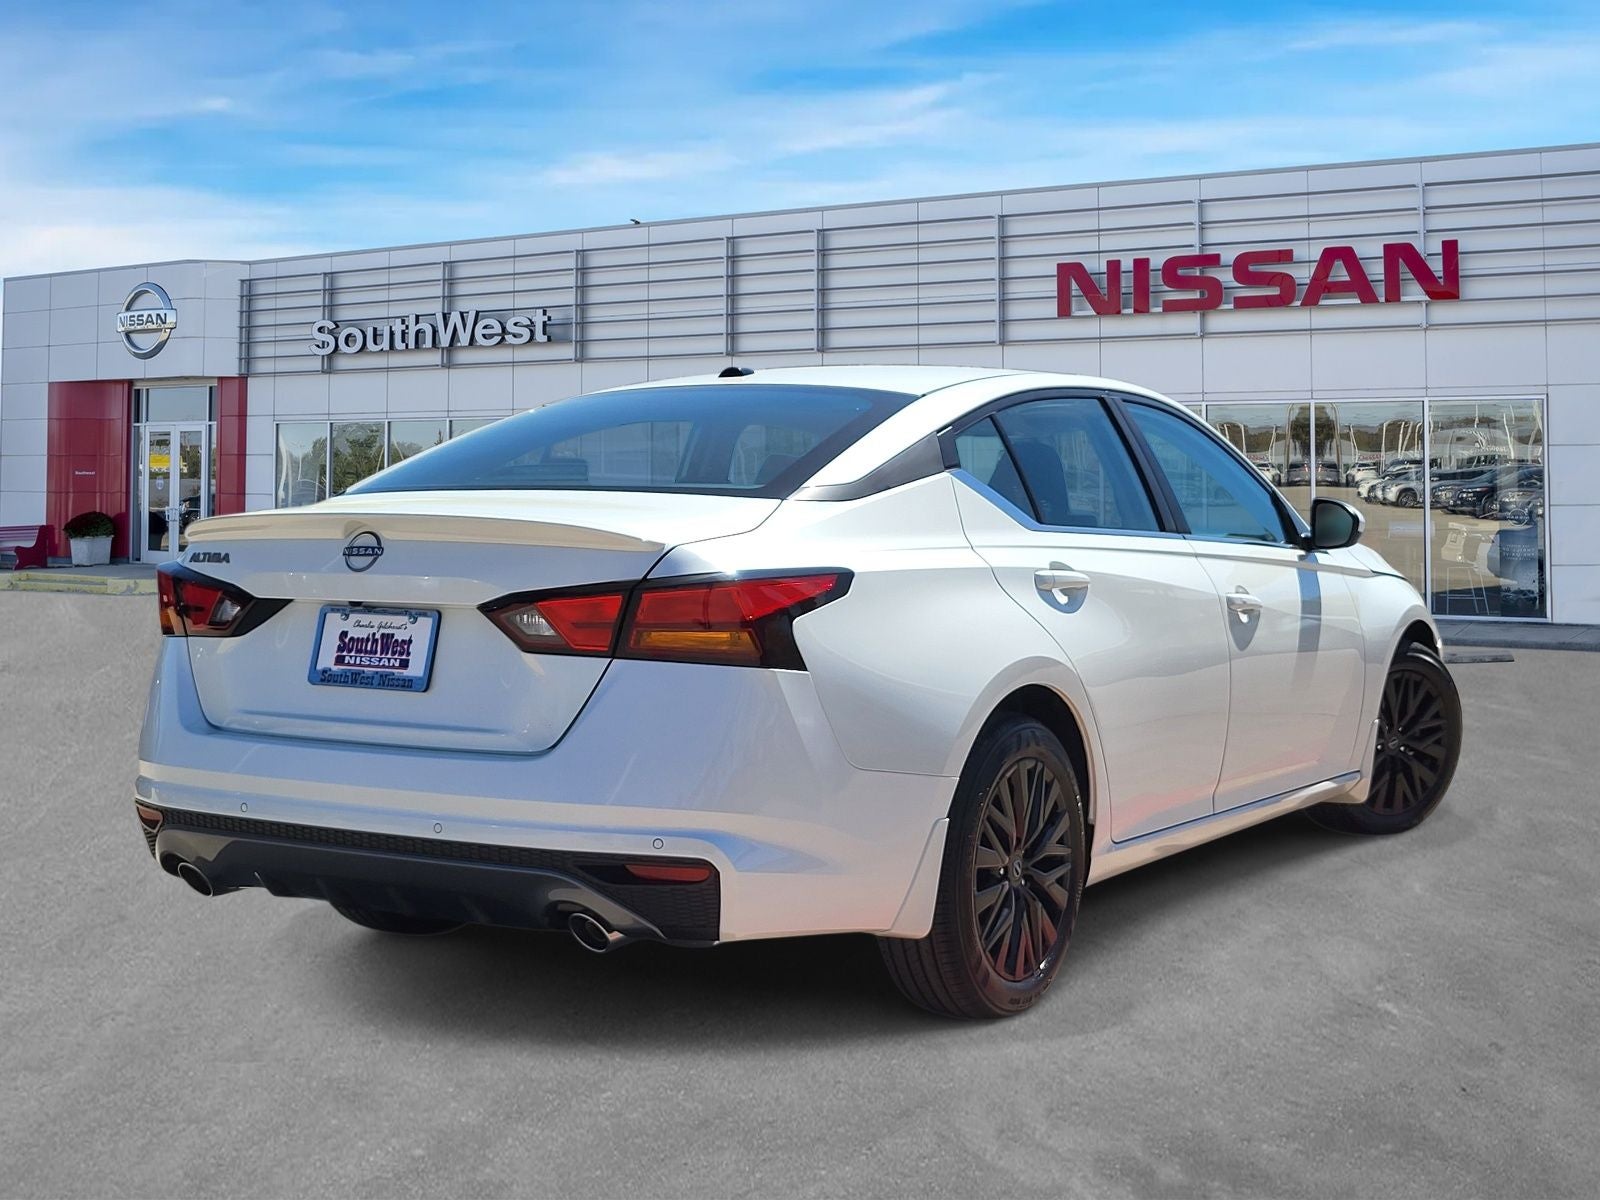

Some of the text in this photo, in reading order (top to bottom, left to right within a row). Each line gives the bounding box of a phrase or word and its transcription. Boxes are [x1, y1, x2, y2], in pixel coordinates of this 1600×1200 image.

[1056, 239, 1460, 318] NISSAN
[118, 313, 167, 328] NISSAN
[309, 308, 551, 356] SouthWest
[189, 552, 230, 563] ALTIMA
[343, 547, 383, 556] NISSAN
[336, 630, 413, 657] SouthWest
[344, 656, 401, 667] NISSAN
[320, 669, 414, 689] SouthWest Nissan
